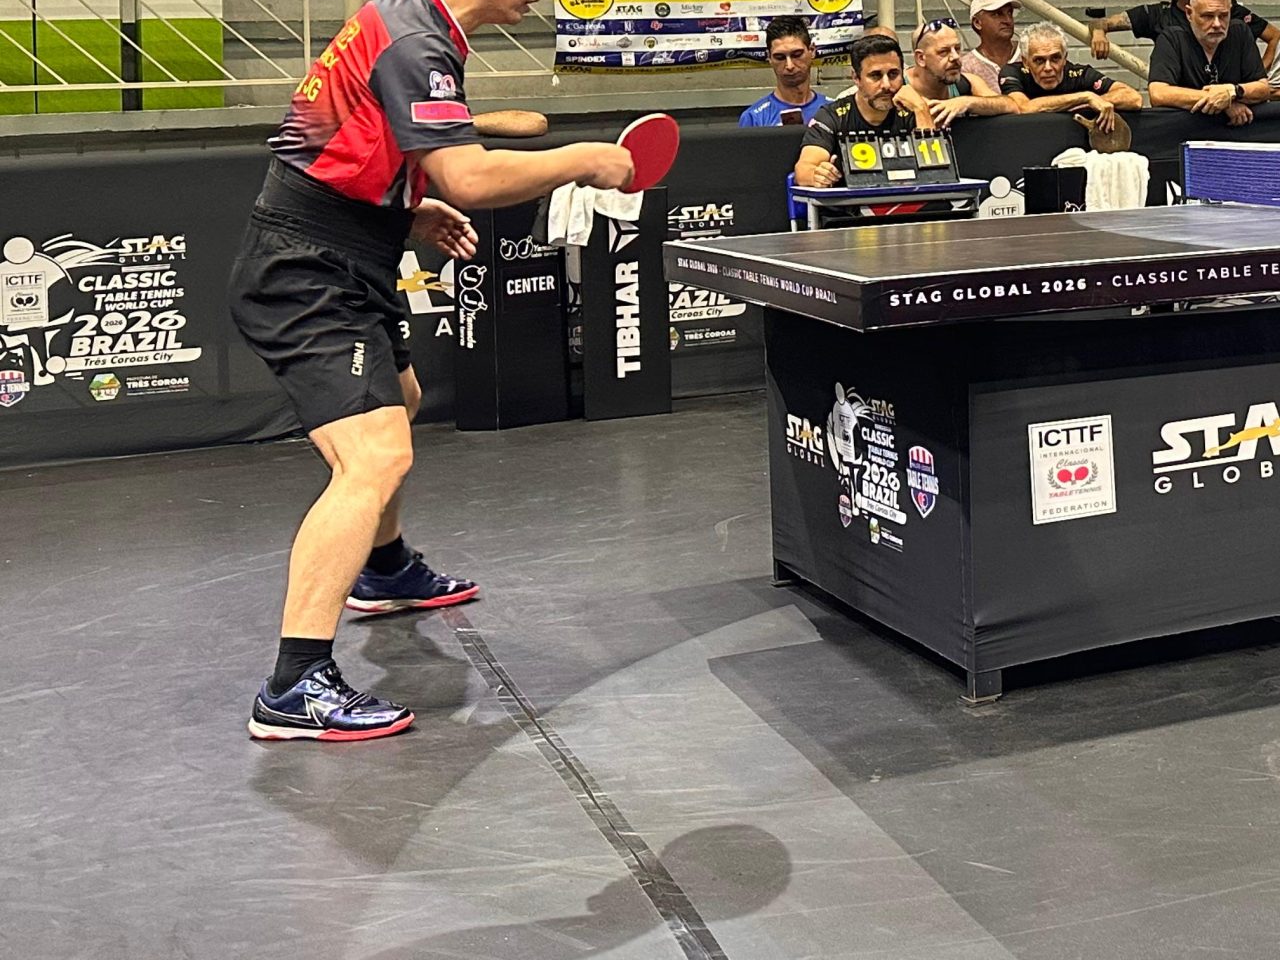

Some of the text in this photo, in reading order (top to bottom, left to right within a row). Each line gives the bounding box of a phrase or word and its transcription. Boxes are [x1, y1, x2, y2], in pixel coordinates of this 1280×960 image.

[851, 139, 945, 169] 9 0 1 11
[680, 203, 734, 220] STAG
[679, 219, 735, 228] GLOBAL
[119, 234, 186, 254] STAG
[119, 254, 187, 263] GLOBAL
[5, 273, 42, 287] ICTTF
[78, 271, 177, 292] CLASSIC
[506, 275, 556, 295] CENTER
[722, 266, 838, 303] CLASSIC TABLE TENNIS WORLD CUP BRAZIL
[889, 289, 943, 307] STAG
[953, 283, 1033, 302] GLOBAL
[1041, 277, 1088, 294] 2026
[1112, 268, 1189, 288] CLASSIC
[1196, 263, 1253, 281] TABLE
[139, 287, 185, 299] TENNIS
[104, 299, 173, 312] WORLD CUP
[671, 309, 703, 319] Coroas
[72, 310, 187, 337] 2026
[615, 260, 641, 379] TIBHAR
[69, 330, 183, 357] BRAZIL
[84, 351, 174, 367] Três Coroas City
[351, 342, 366, 376] CHINA
[126, 376, 189, 389] TRÊS COROAS
[786, 413, 824, 451] STAG
[861, 427, 895, 448] CLASSIC
[1038, 424, 1103, 449] ICTTF
[787, 444, 824, 468] GLOBAL
[1056, 457, 1089, 469] Classic
[862, 461, 900, 491] 2026
[862, 480, 900, 508] BRAZIL
[1042, 500, 1108, 516] FEDERATION
